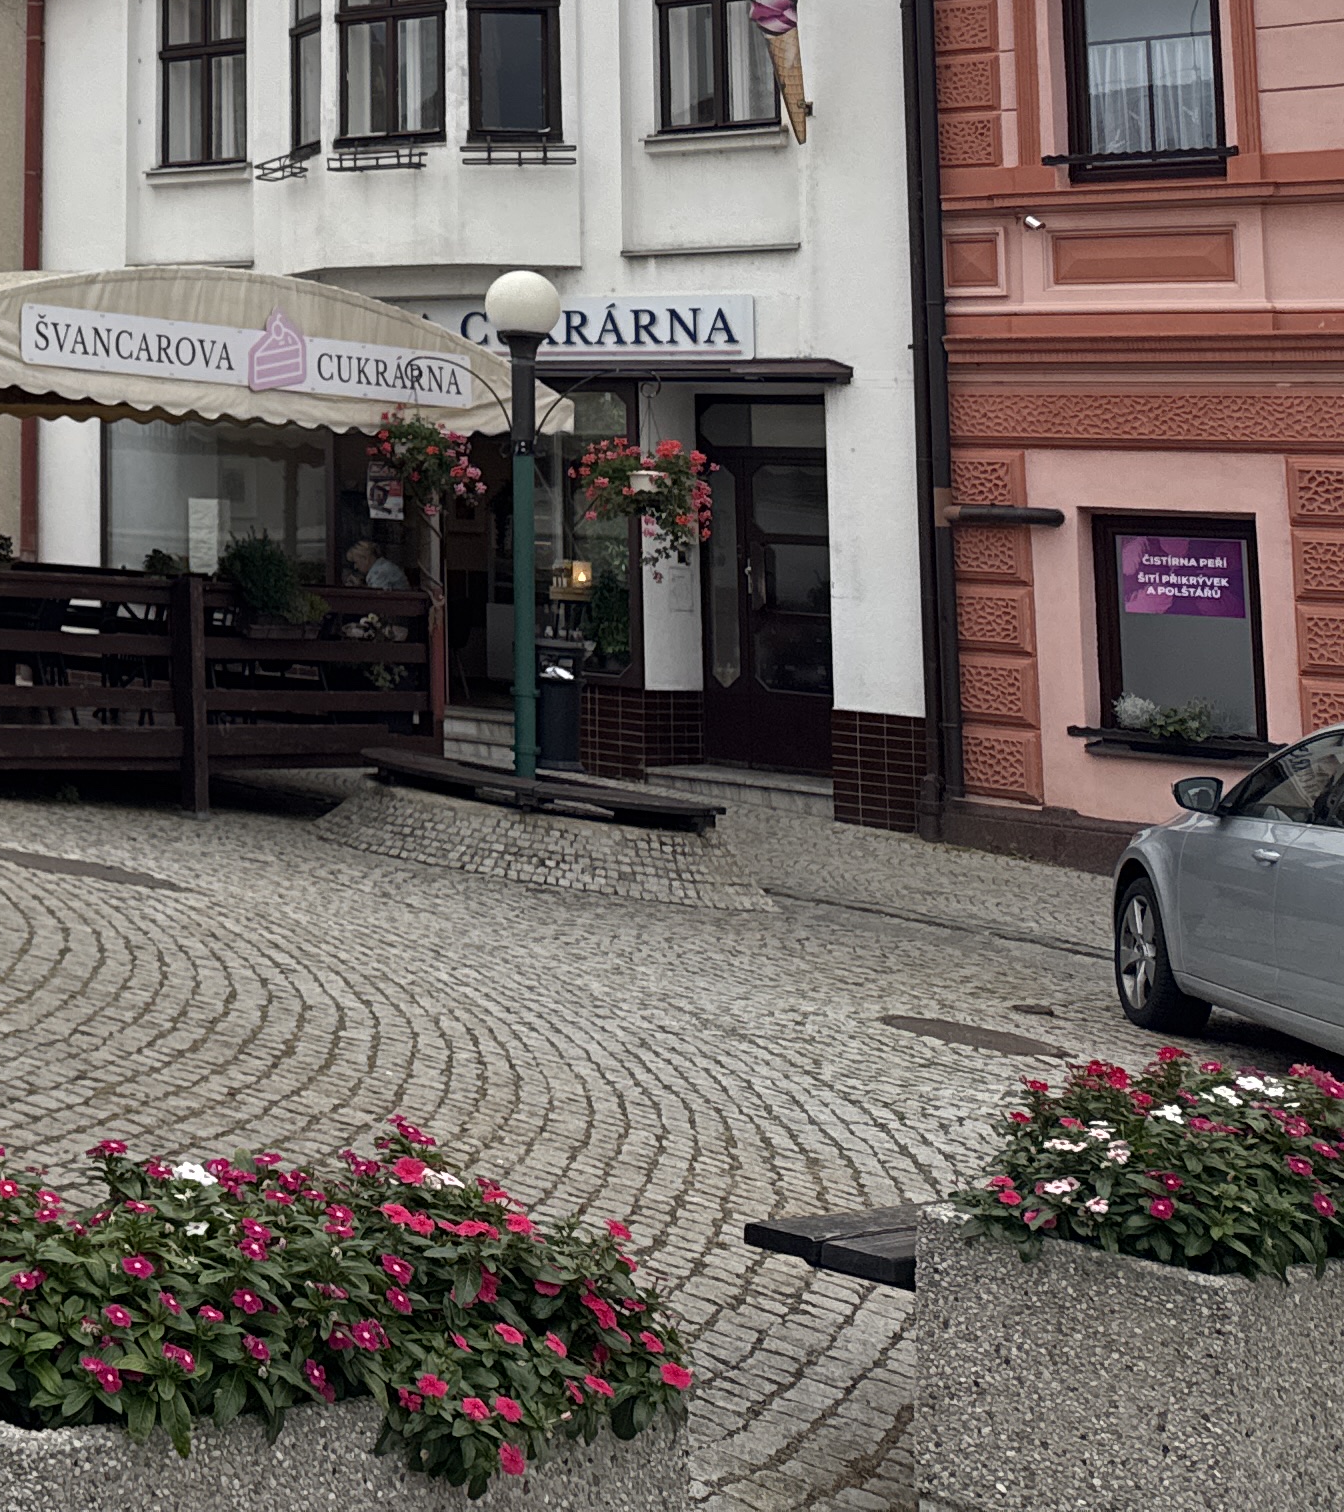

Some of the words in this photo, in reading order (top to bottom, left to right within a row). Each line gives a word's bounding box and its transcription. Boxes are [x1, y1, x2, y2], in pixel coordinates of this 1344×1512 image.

[460, 302, 740, 346] CRÁRNA
[34, 313, 235, 371] ŠVANCAROVA
[317, 352, 462, 395] CUKRÁRNA
[1142, 554, 1198, 567] ČISTÍRNA
[1199, 556, 1227, 569] PEŘÍ
[1137, 571, 1160, 584] ŠITÍ
[1161, 573, 1230, 587] PŘIKRÝVEK
[1146, 586, 1156, 595] A
[1157, 585, 1221, 599] POLŠTÁŘŮ
